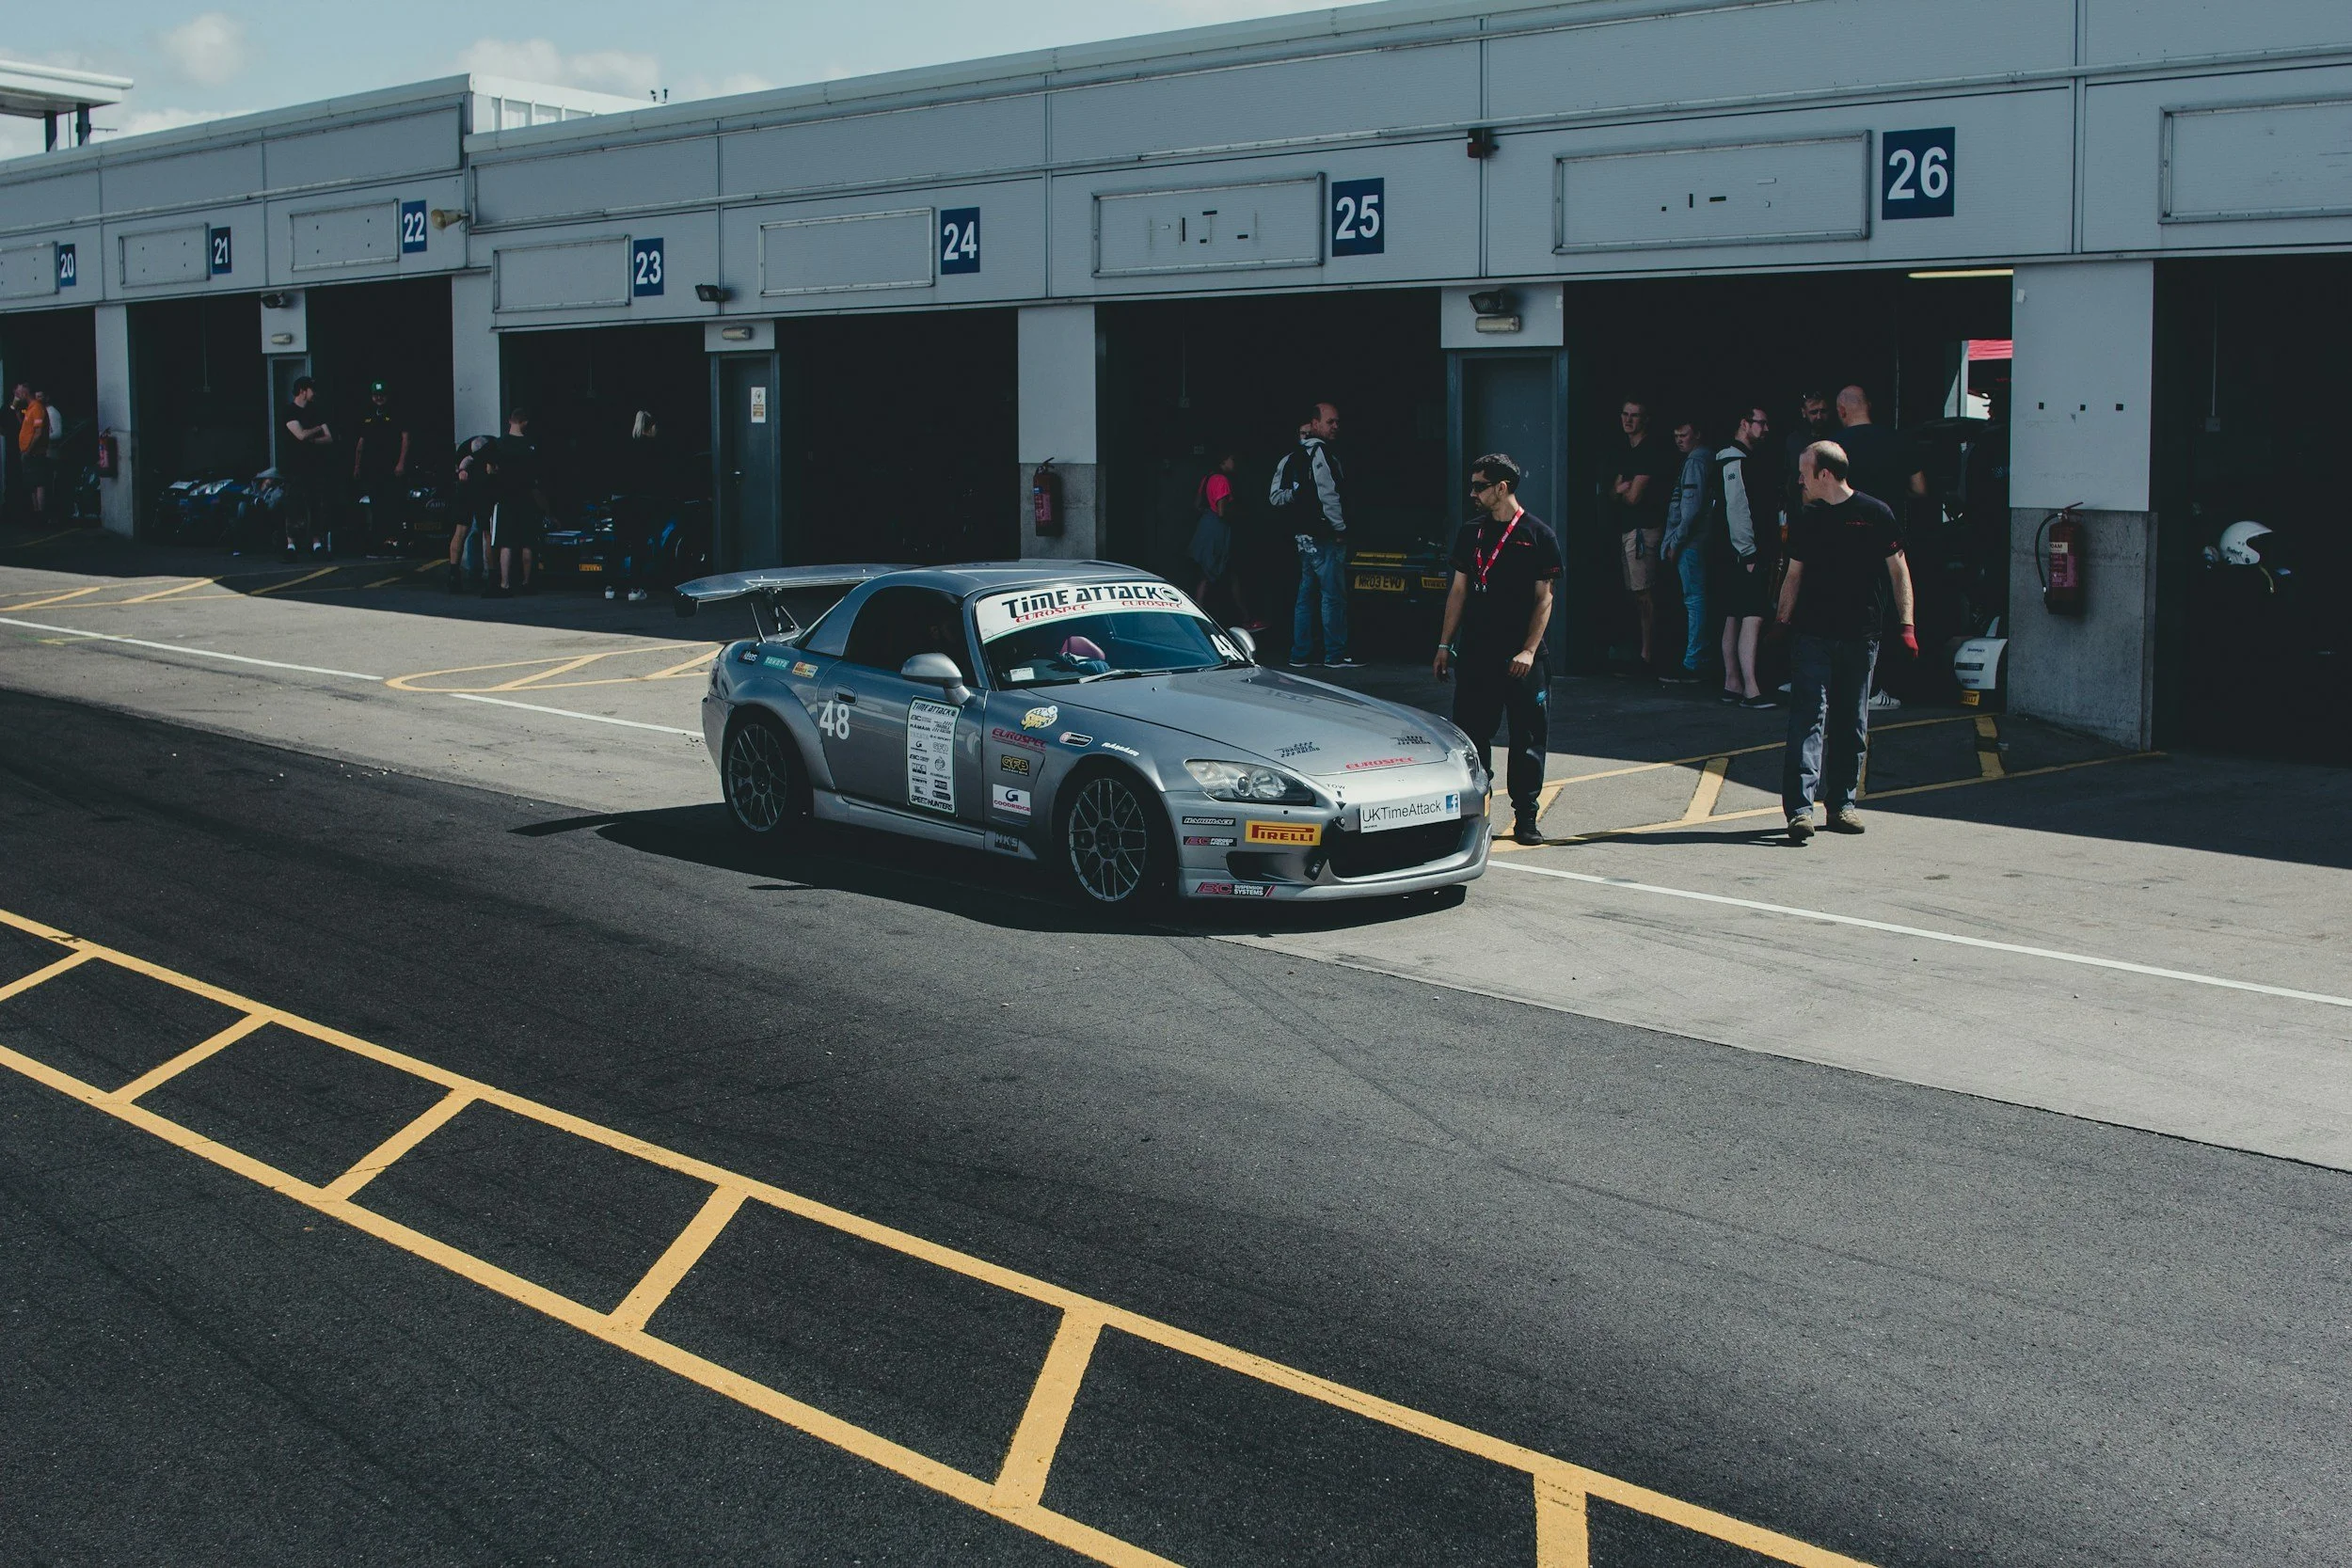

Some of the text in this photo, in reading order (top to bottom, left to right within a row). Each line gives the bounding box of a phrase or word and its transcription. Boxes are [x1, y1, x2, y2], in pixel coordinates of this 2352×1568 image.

[1887, 147, 1948, 200] 26
[405, 211, 424, 244] 22
[1335, 195, 1381, 240] 25
[215, 236, 229, 264] 21
[943, 221, 978, 261] 24
[60, 253, 74, 278] 20
[636, 250, 661, 285] 23
[1075, 586, 1165, 603] ATTACK
[1121, 600, 1182, 610] EUROSPEC
[1015, 604, 1091, 623] EUROSPEC
[1210, 634, 1245, 661] 48
[765, 657, 789, 668] TAKATA
[818, 700, 850, 740] 48
[992, 728, 1048, 749] EUROSPEC
[1345, 756, 1417, 770] EUROSPEC
[911, 794, 954, 811] SPEEDHUNTERS
[993, 800, 1032, 812] GOODRIDGE
[1362, 800, 1441, 822] UKTimeAttack
[995, 833, 1018, 847] HKS
[1251, 825, 1315, 843] PIRELLI
[1197, 882, 1232, 895] BC
